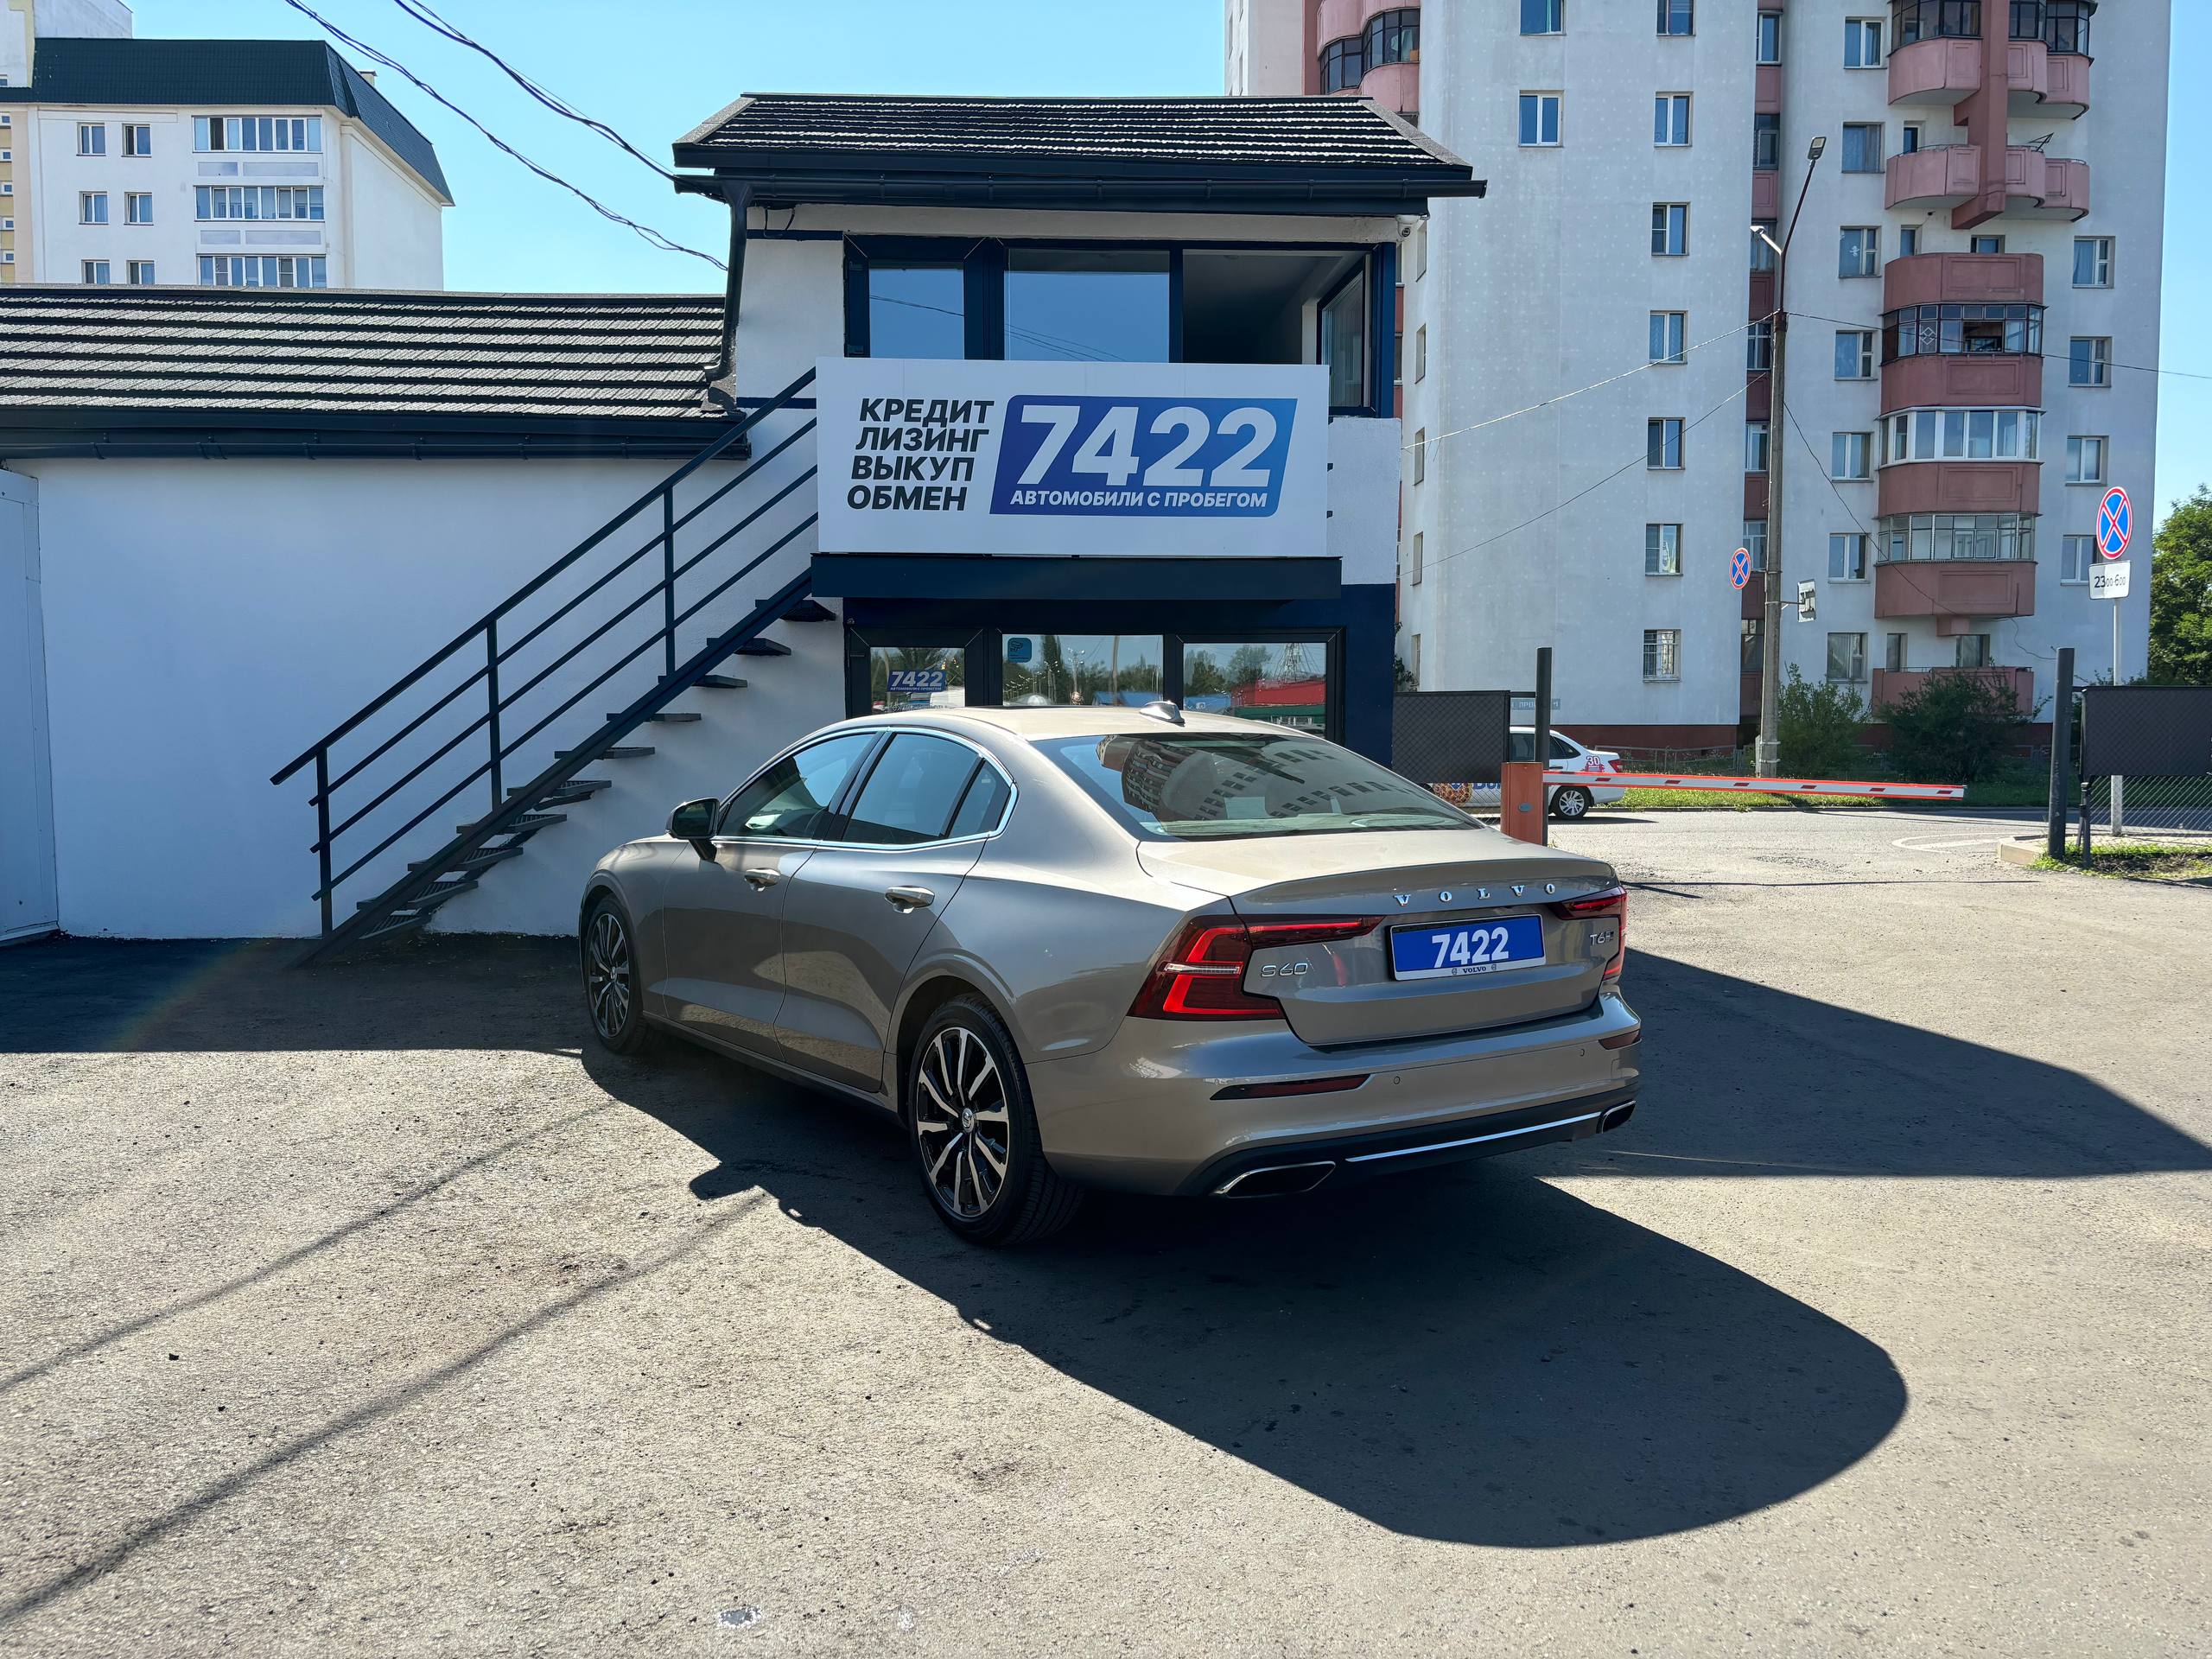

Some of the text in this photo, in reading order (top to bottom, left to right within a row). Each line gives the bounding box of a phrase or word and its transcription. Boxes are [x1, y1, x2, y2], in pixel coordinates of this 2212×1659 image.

[859, 397, 995, 428] КРЕДИТ
[855, 426, 989, 452] ЛИЗИНГ
[1016, 404, 1277, 487] 7422
[851, 455, 975, 481] ВЫКУП
[847, 485, 968, 511] ОБМЕН
[1010, 490, 1268, 507] АВТОМОБИЛИ С ПРОБЕГОМ
[891, 671, 943, 687] 7422
[1586, 755, 1601, 766] 30
[1394, 883, 1555, 906] VOLVO
[1432, 926, 1510, 969] 7422
[1262, 963, 1308, 977] S60
